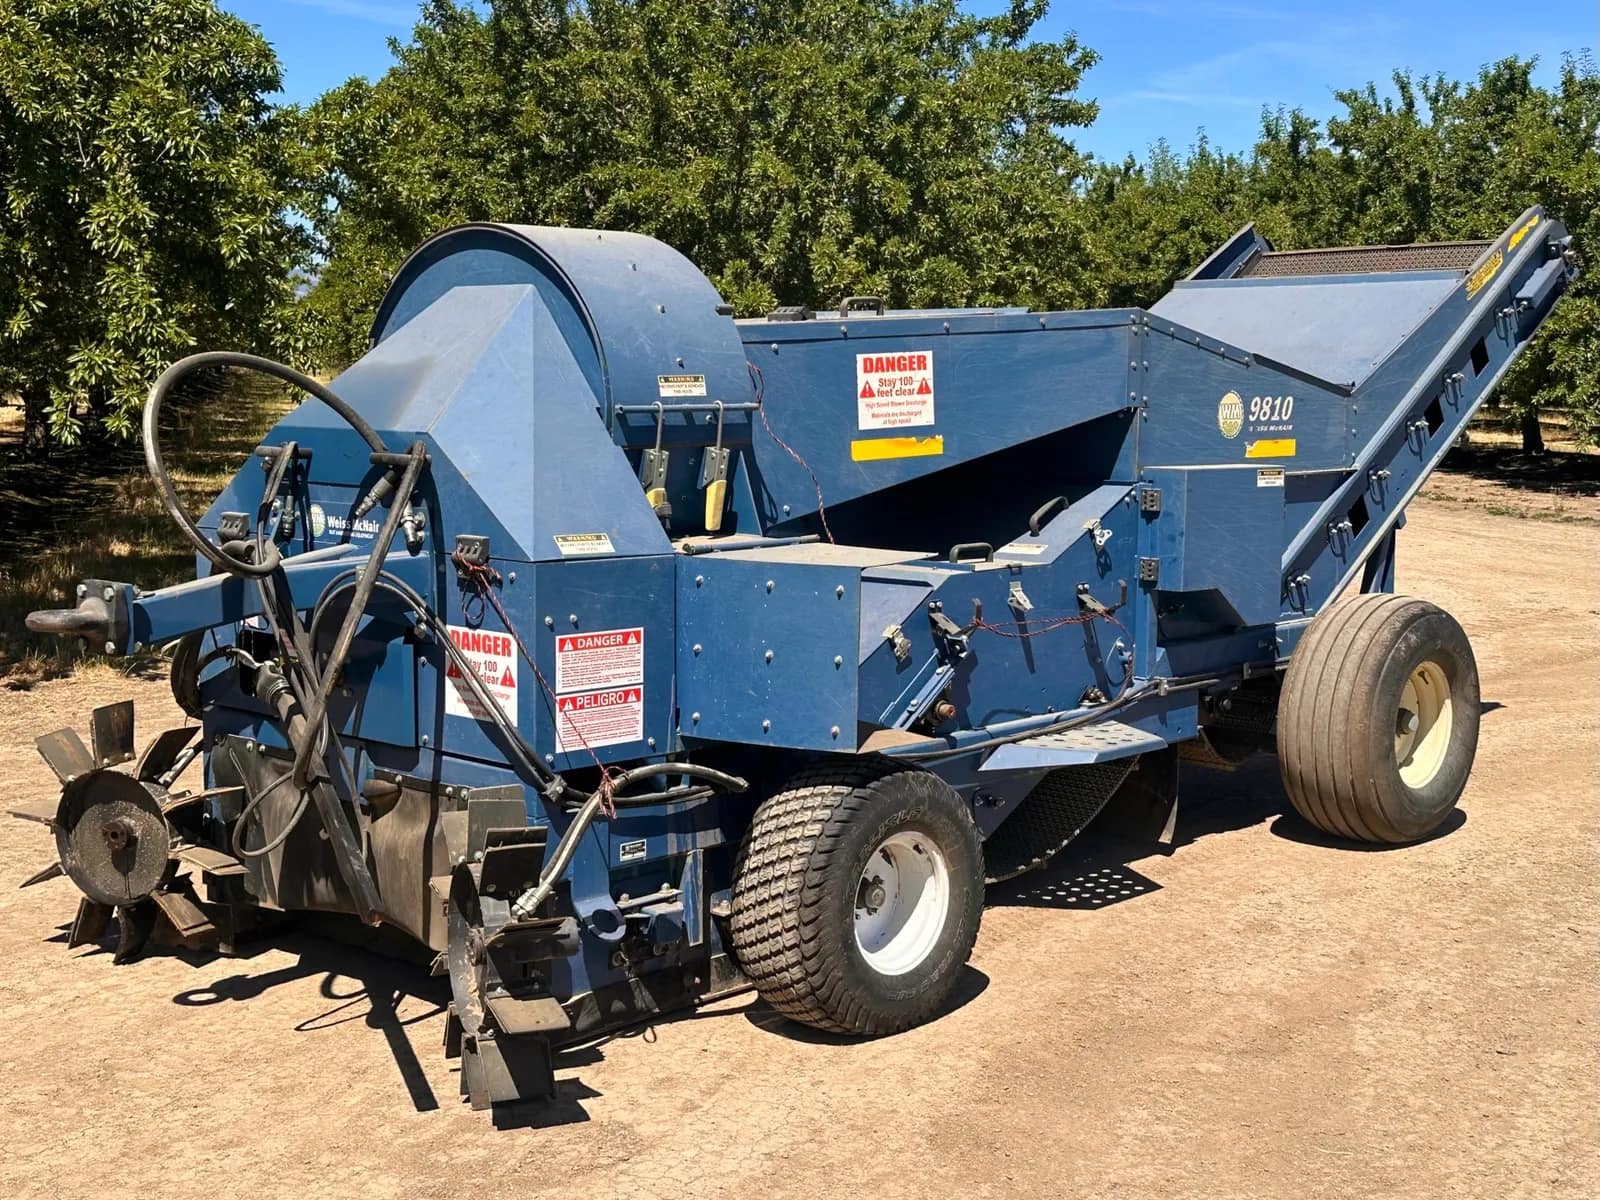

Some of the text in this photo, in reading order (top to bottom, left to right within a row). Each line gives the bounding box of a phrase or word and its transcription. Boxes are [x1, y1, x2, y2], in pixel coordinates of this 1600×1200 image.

[863, 355, 927, 374] DANGER
[878, 376, 913, 389] Stay 100
[877, 387, 915, 397] feet clear
[1222, 403, 1240, 419] WM
[1249, 396, 1294, 421] 9810
[327, 515, 380, 533] Weiss McNair
[451, 629, 512, 657] DANGER
[577, 634, 624, 649] DANGER
[467, 658, 497, 672] tay 100
[576, 691, 625, 709] PELIGRO
